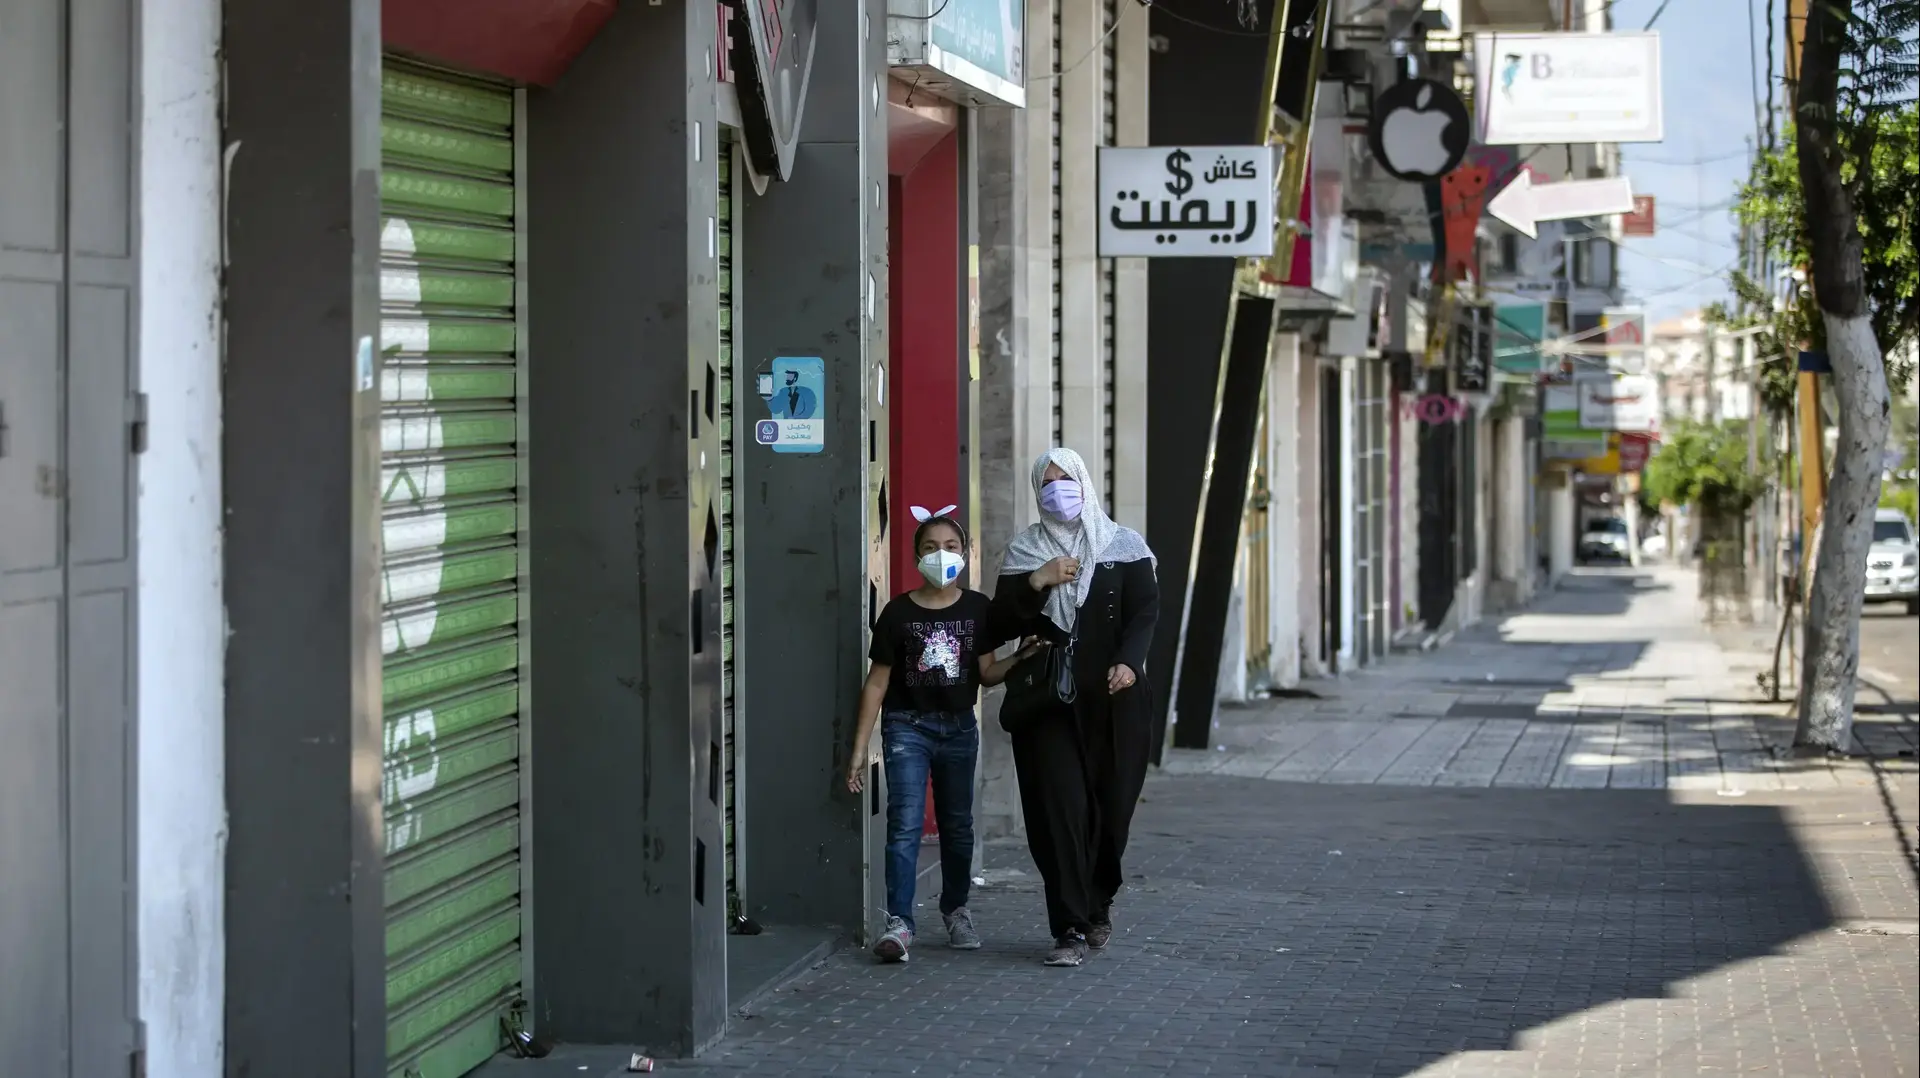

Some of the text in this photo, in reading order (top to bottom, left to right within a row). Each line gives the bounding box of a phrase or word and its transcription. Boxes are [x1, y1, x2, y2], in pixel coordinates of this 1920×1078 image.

[1164, 148, 1257, 200] كاش $
[1110, 190, 1257, 245] ريميت
[904, 620, 974, 635] SPARKLE
